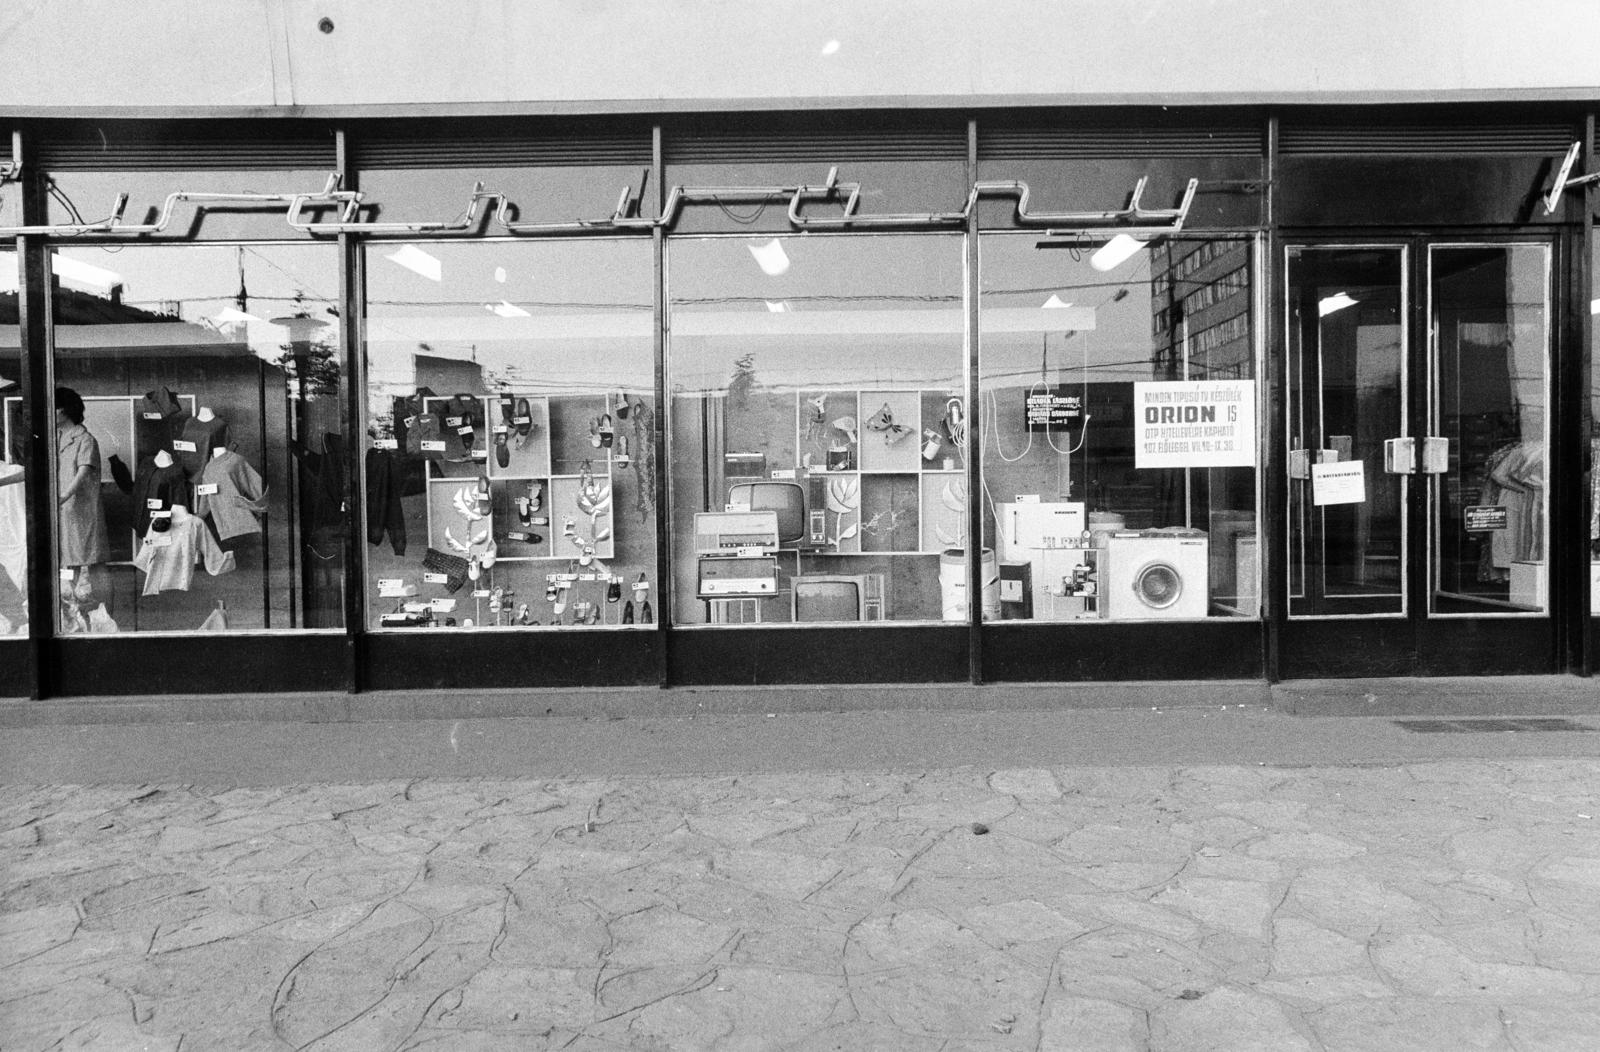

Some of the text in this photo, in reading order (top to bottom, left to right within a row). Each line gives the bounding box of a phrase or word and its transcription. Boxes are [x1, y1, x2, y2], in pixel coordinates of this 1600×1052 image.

[1144, 391, 1172, 403] MINDEN
[1200, 391, 1209, 402] TV
[1210, 385, 1242, 402] KÉSZÜLÉK
[1145, 405, 1237, 424] ORION IS
[1145, 427, 1159, 439] OTP
[1203, 423, 1234, 437] KAPHATÓ
